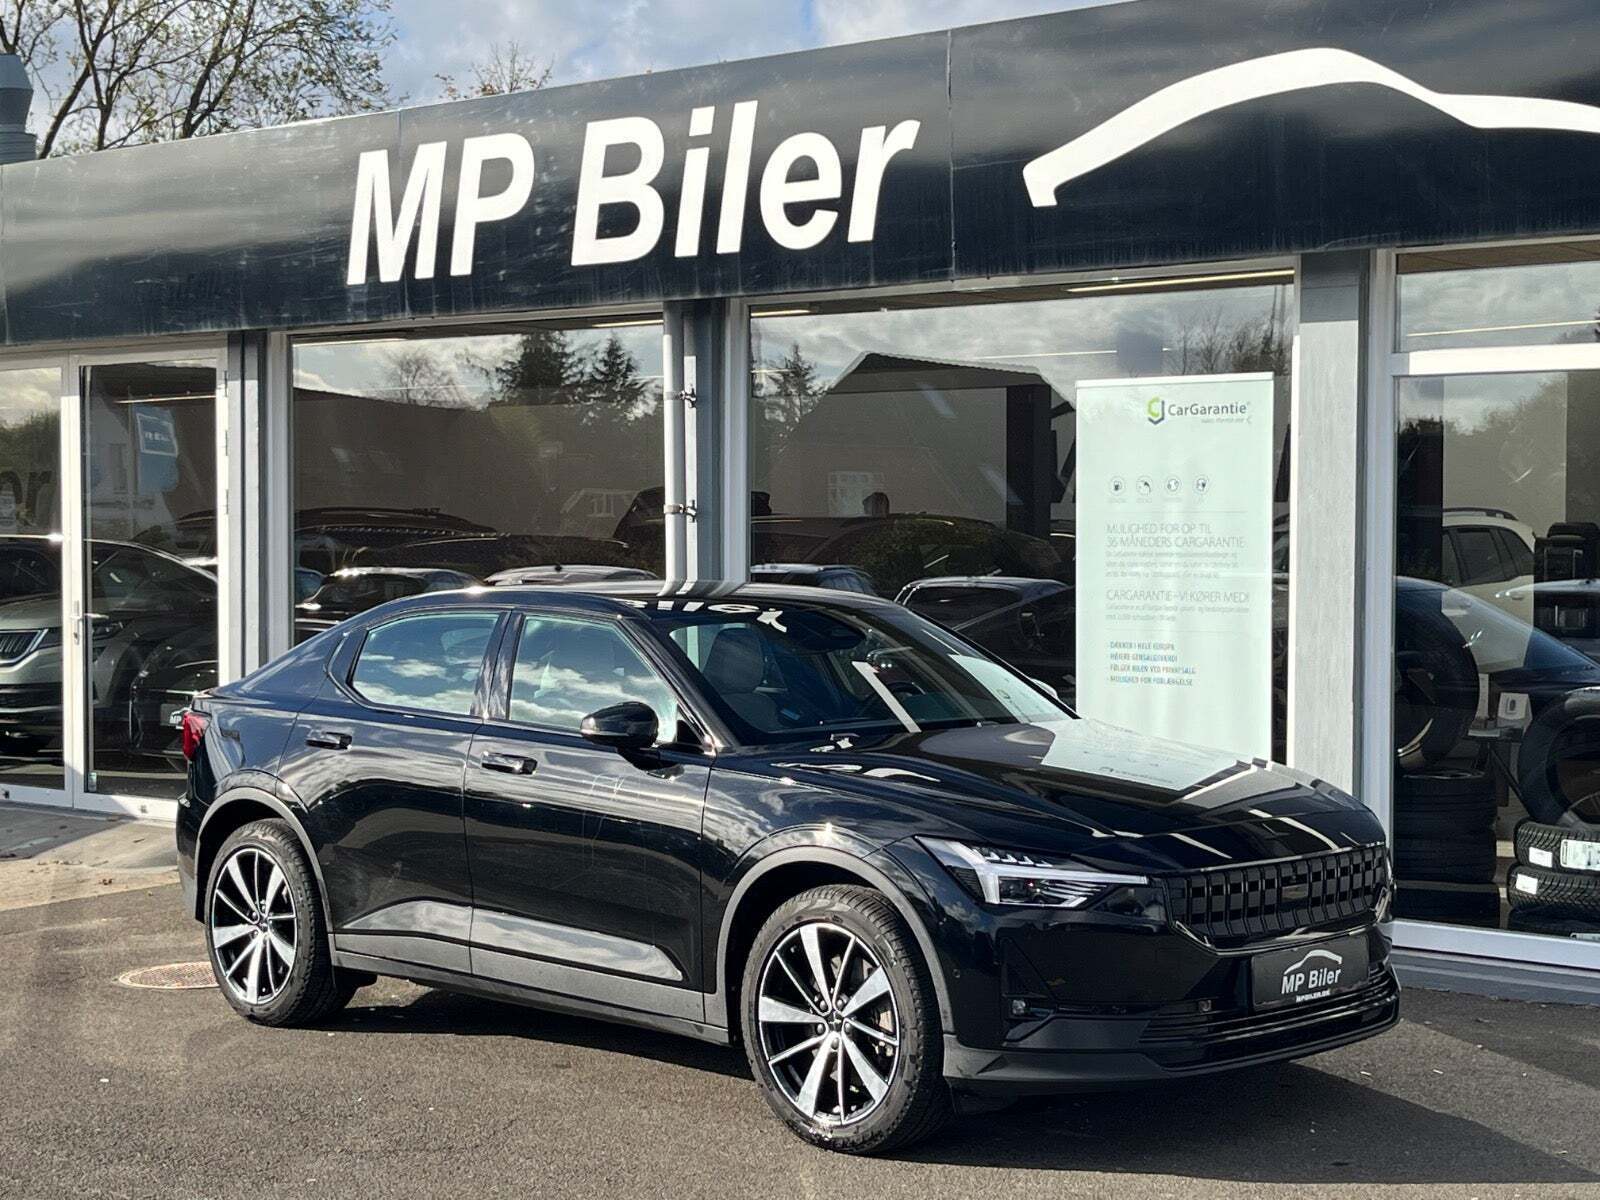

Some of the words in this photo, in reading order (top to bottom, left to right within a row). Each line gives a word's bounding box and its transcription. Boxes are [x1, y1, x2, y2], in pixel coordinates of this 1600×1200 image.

[346, 132, 535, 286] MP
[571, 100, 921, 266] Biler
[1167, 401, 1247, 417] CarGarantie
[1281, 974, 1304, 994] MP
[1308, 968, 1341, 989] Biler
